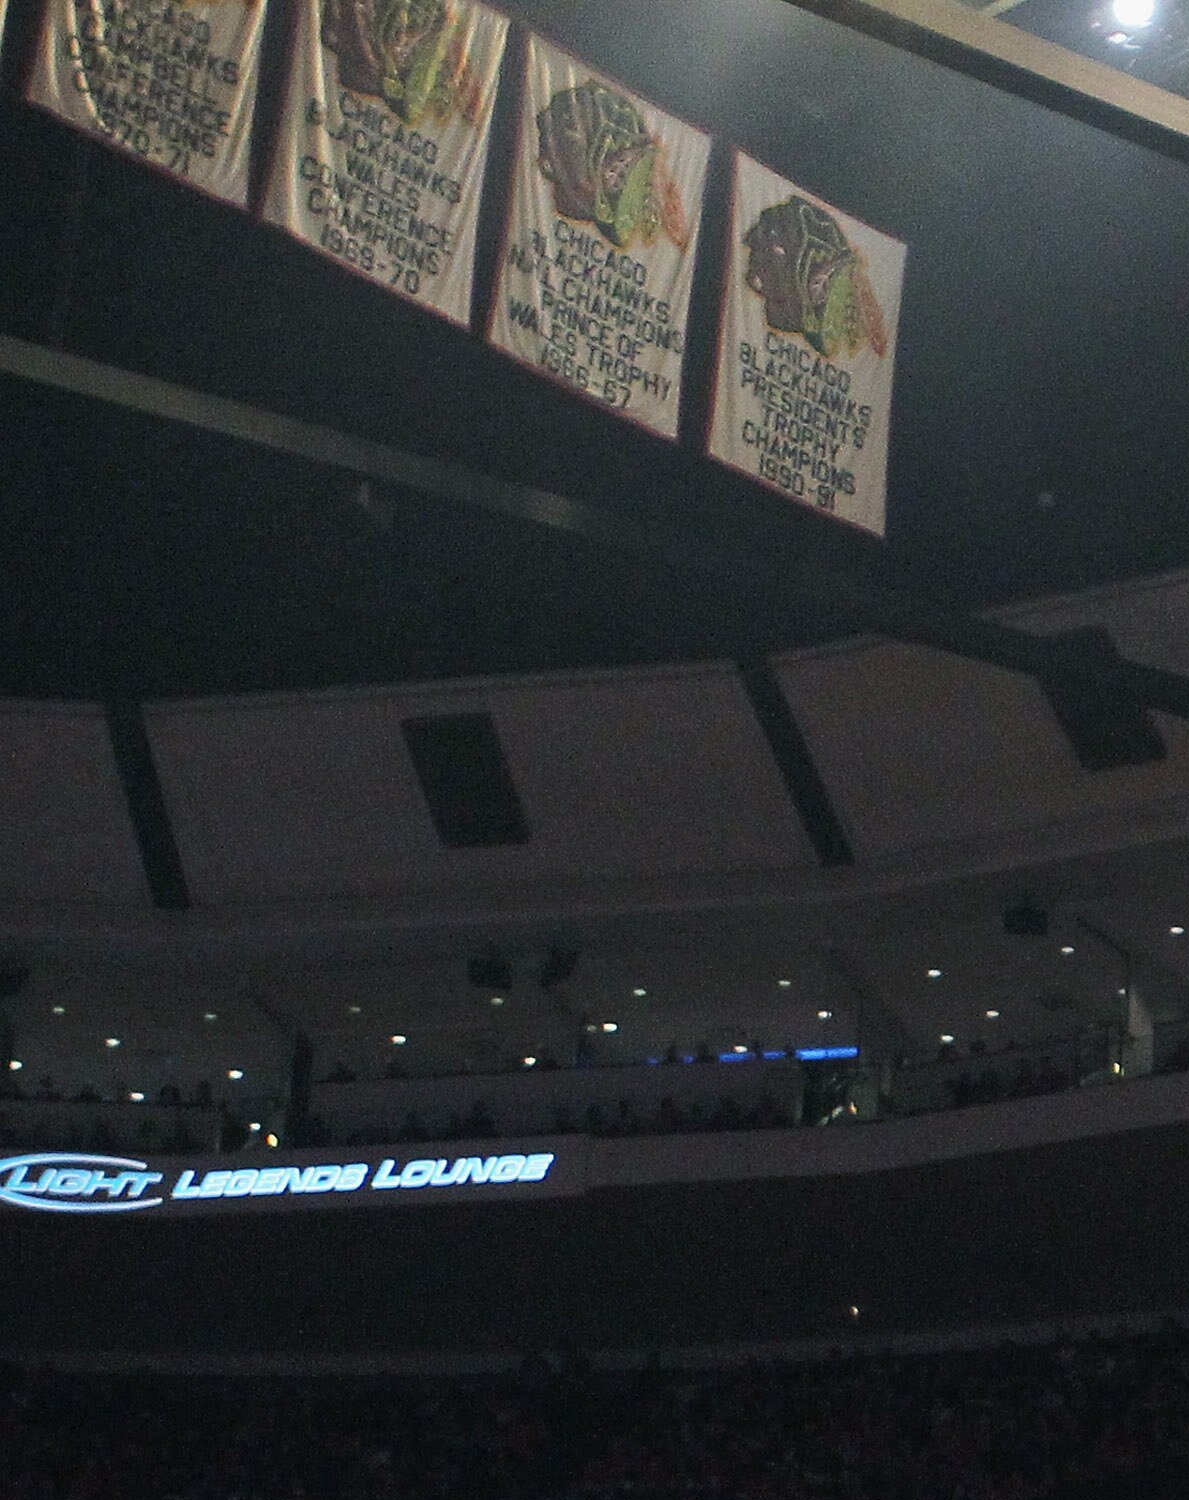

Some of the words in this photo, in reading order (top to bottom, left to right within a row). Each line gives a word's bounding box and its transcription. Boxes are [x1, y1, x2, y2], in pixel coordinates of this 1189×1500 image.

[554, 220, 648, 286] CHICAGO
[541, 288, 613, 350] PRINCE
[616, 333, 645, 363] OF
[586, 341, 672, 401] TROPHY
[739, 341, 872, 428] BLACKHAWKS
[765, 330, 851, 394] CHICAGO
[741, 419, 856, 495] CHAMPIONS
[762, 401, 841, 462] TROPHY
[171, 1163, 368, 1199] LEGENDS
[371, 1153, 554, 1190] LOUNGE
